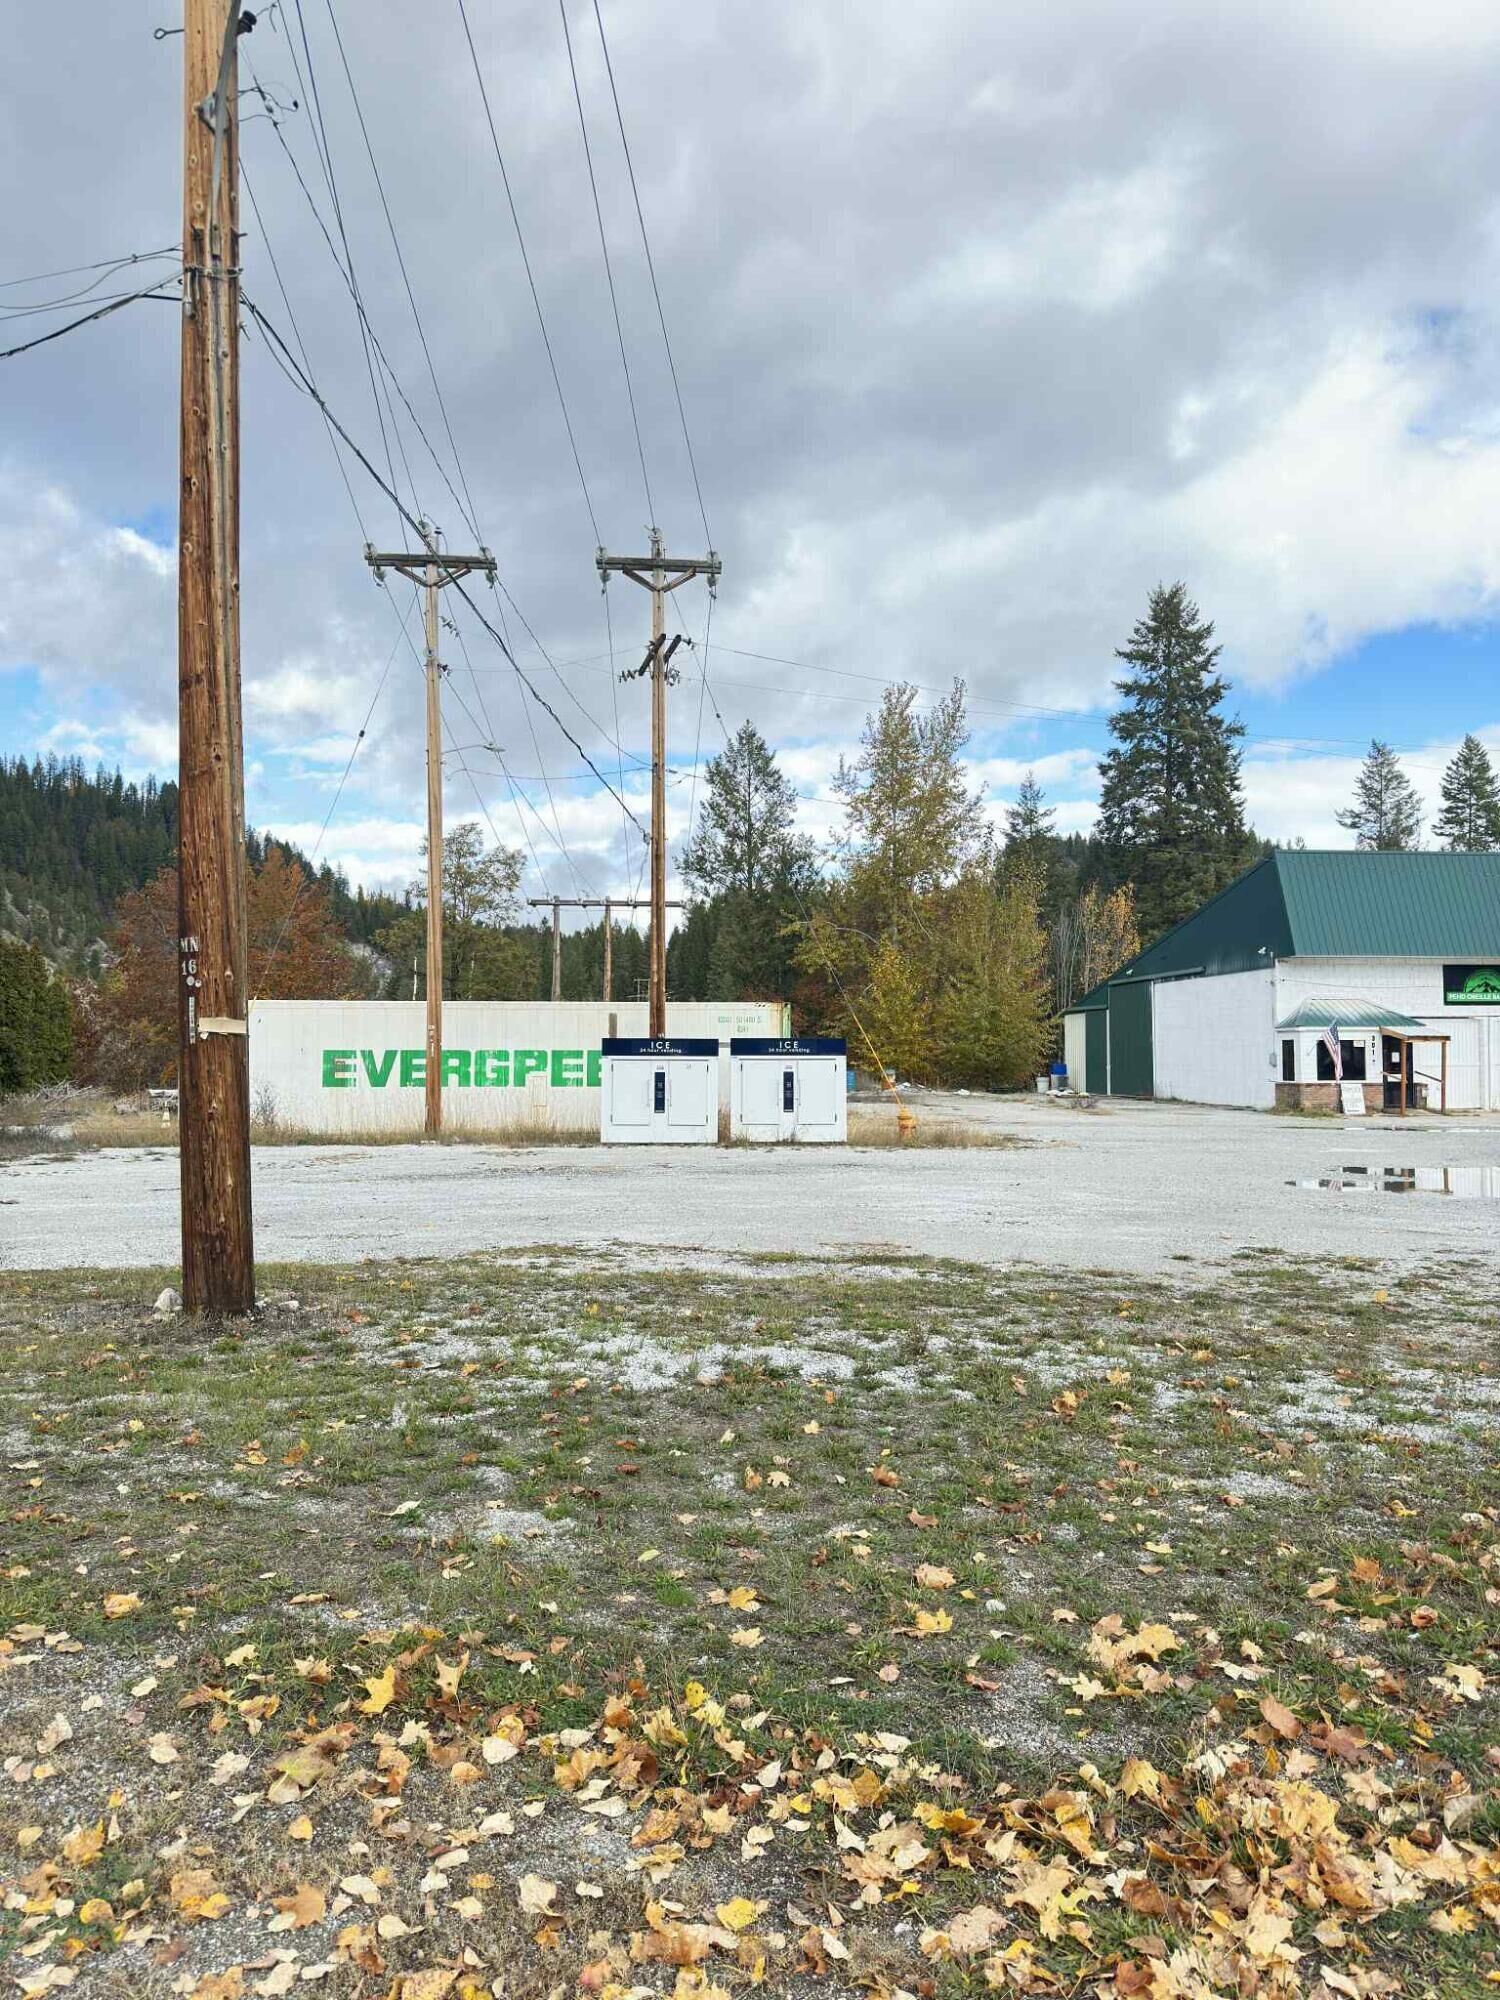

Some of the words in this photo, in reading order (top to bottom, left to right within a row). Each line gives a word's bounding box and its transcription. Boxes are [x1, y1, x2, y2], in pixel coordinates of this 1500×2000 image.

[180, 937, 199, 952] MN
[181, 960, 197, 975] 16
[651, 1041, 671, 1049] ICE
[779, 1041, 799, 1049] ICE
